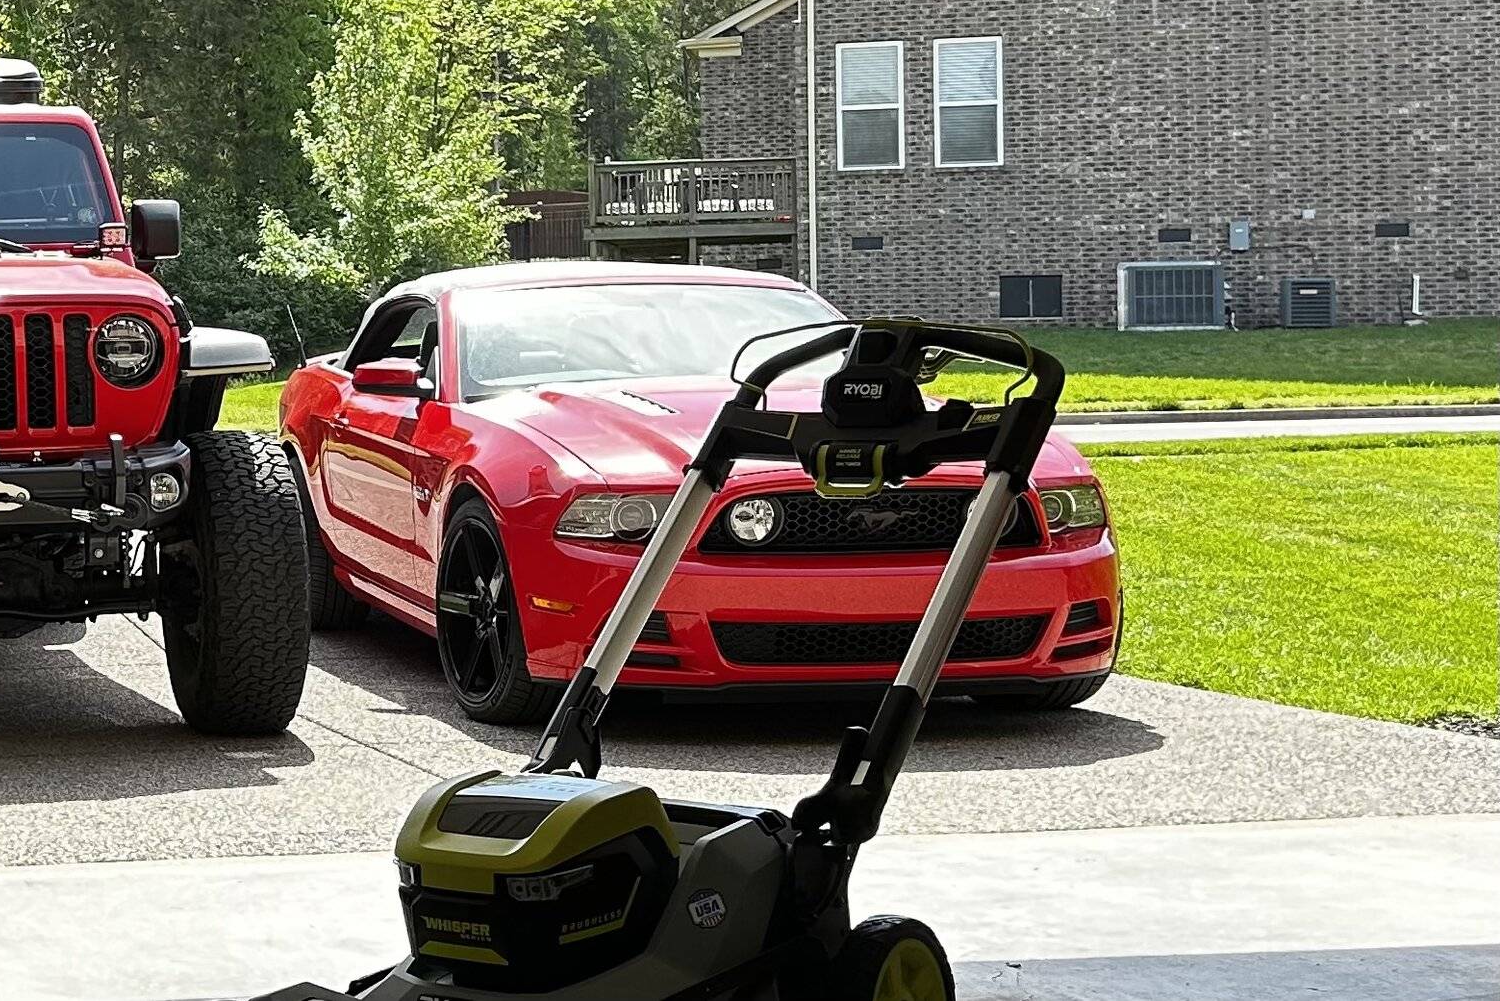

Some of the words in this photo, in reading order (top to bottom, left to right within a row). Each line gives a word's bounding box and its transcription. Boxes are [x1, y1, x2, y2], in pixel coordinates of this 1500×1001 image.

[844, 383, 884, 396] RYOBI
[695, 899, 721, 917] USA
[419, 916, 491, 937] WHISPER
